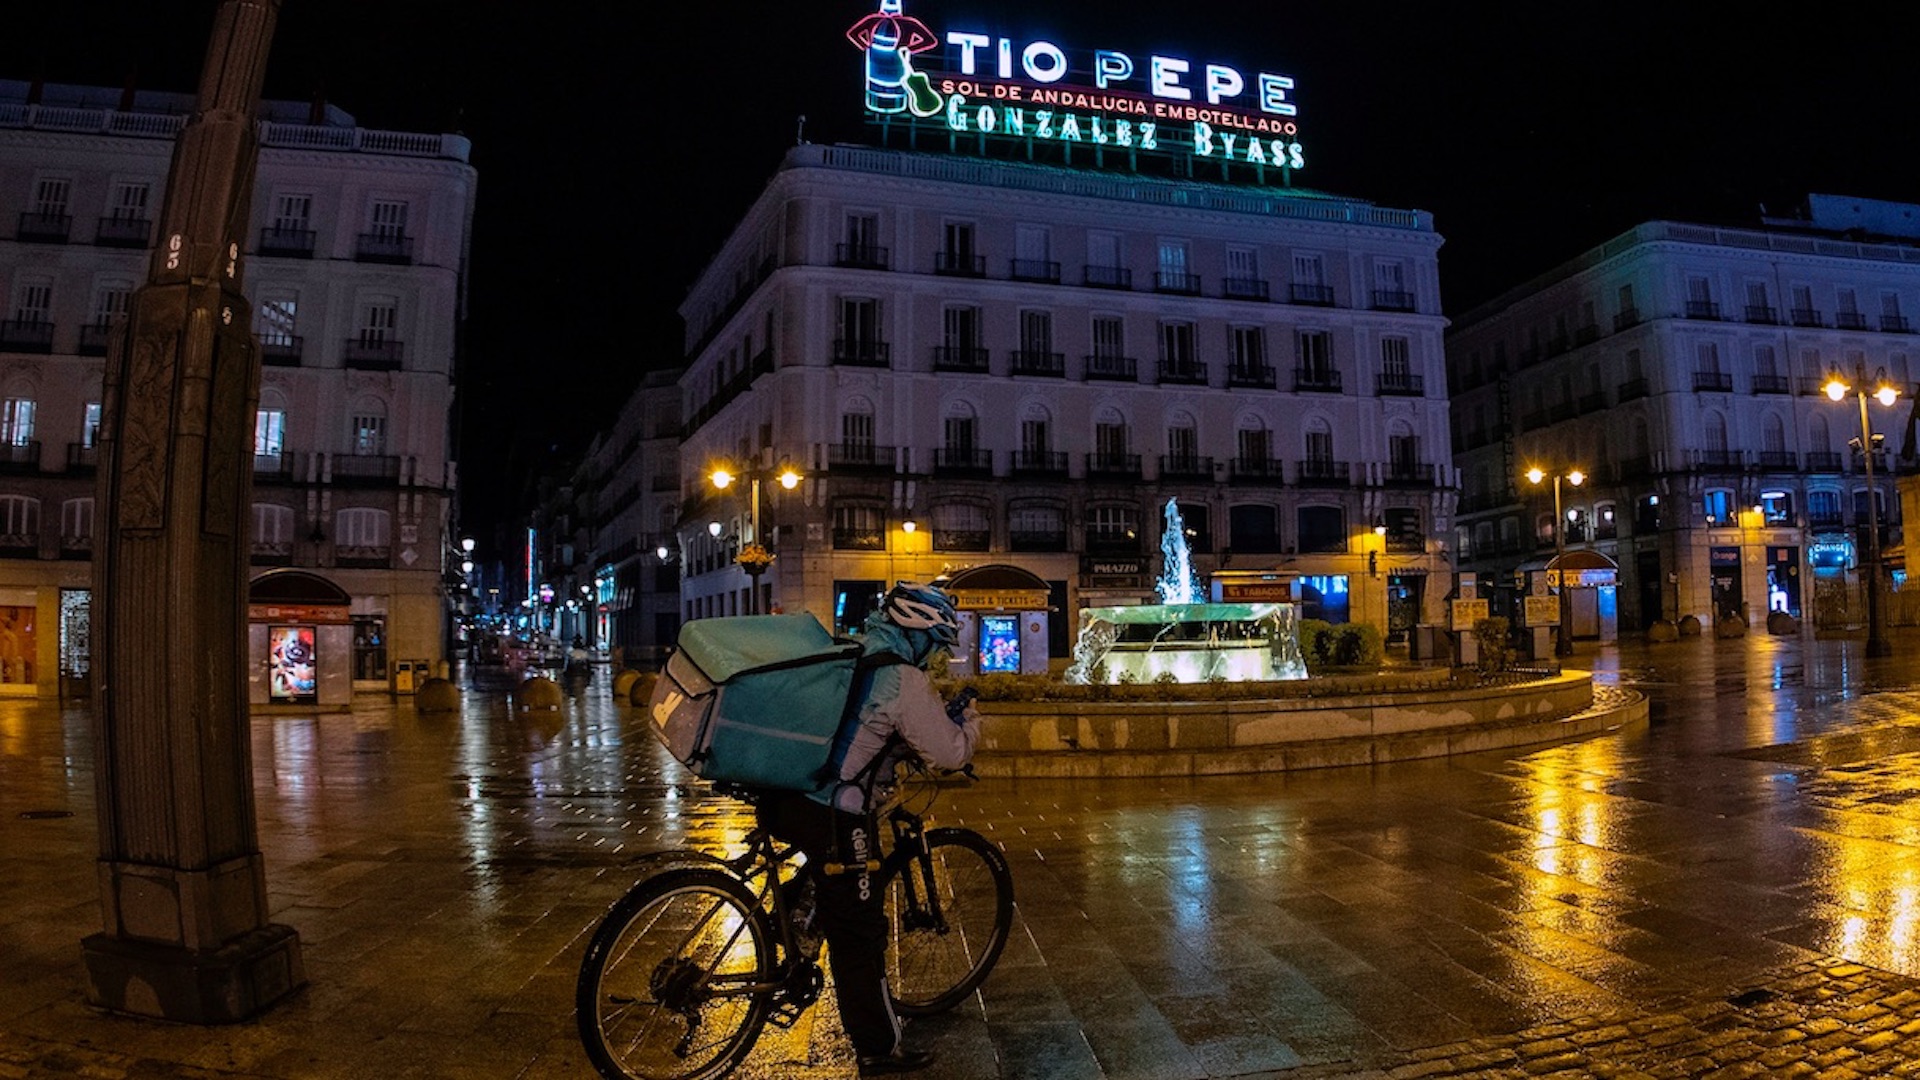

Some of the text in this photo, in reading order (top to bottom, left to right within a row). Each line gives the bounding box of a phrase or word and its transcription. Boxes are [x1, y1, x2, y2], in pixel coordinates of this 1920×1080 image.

[946, 31, 1297, 116] TIO PEPE
[942, 80, 1298, 135] SOL DE ANDALUCIA EMBOTELLADO
[960, 595, 986, 607] TOURS
[987, 595, 995, 606] &
[997, 595, 1029, 607] TICKETS
